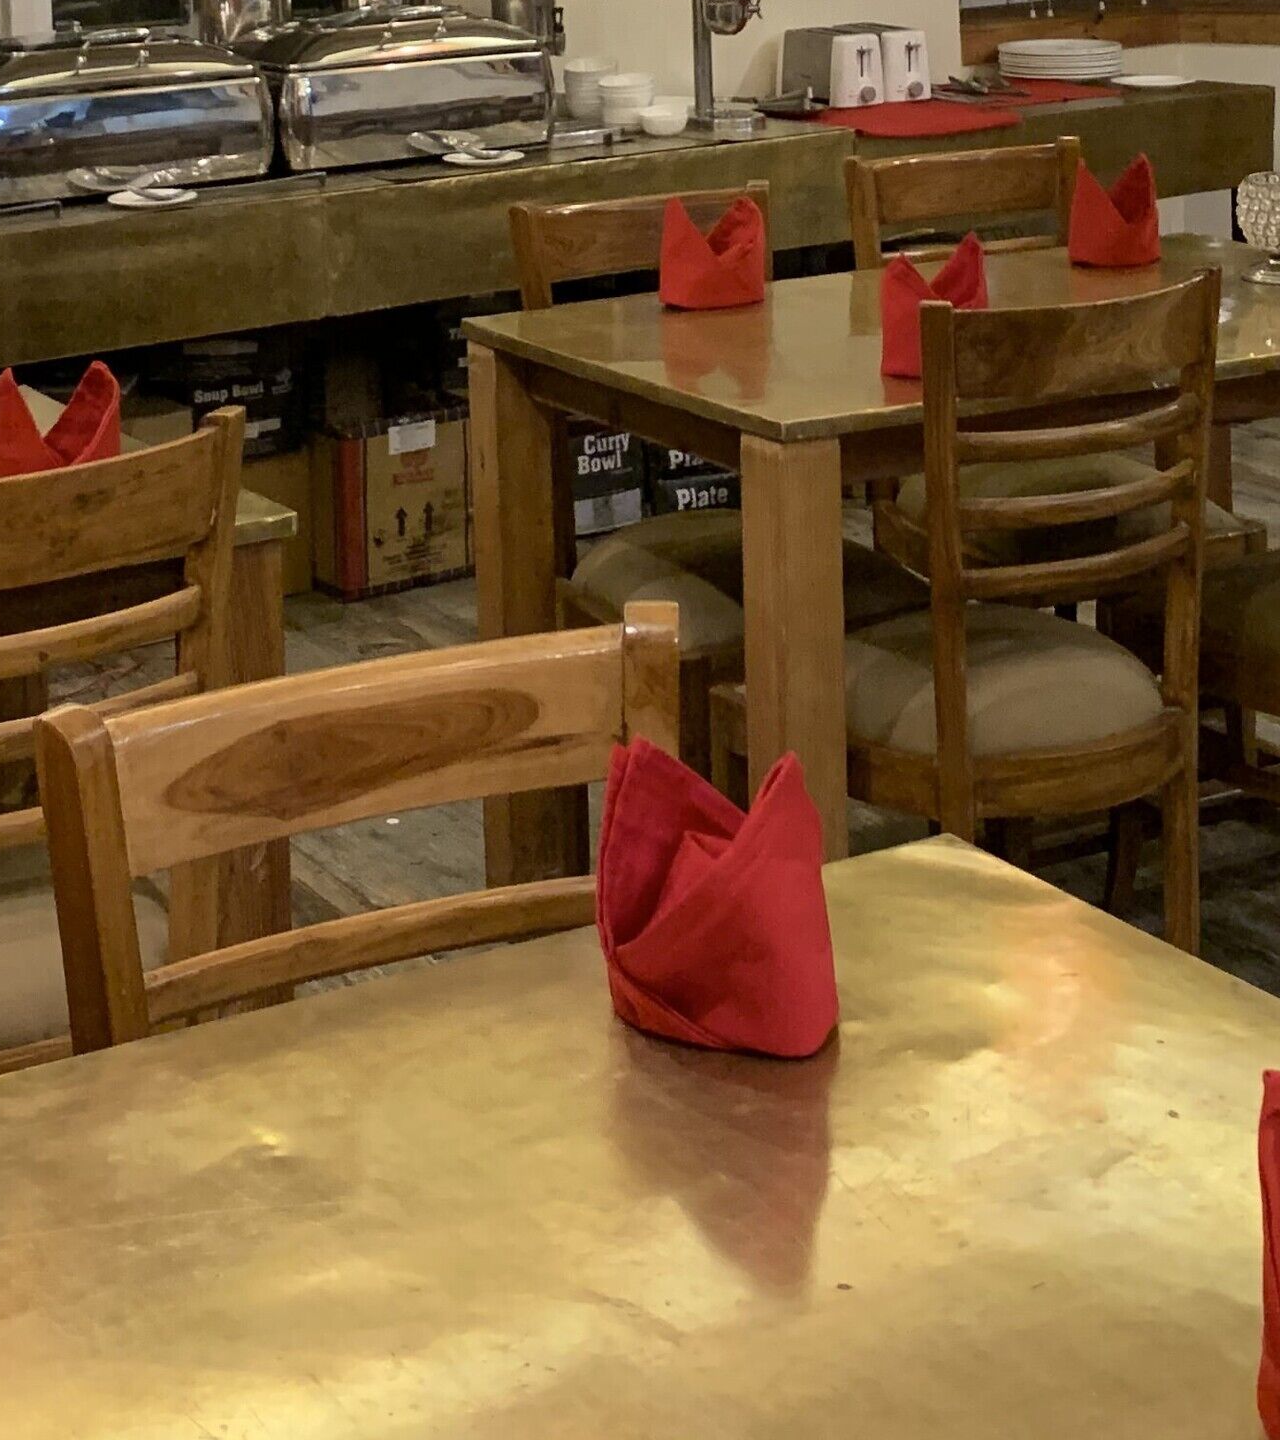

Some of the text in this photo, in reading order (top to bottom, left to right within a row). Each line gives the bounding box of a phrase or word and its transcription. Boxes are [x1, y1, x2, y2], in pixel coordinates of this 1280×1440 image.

[194, 389, 228, 404] Soup
[231, 380, 265, 398] Bowl
[583, 432, 630, 455] Curry
[577, 450, 622, 475] Bowl
[675, 485, 729, 510] Plate
